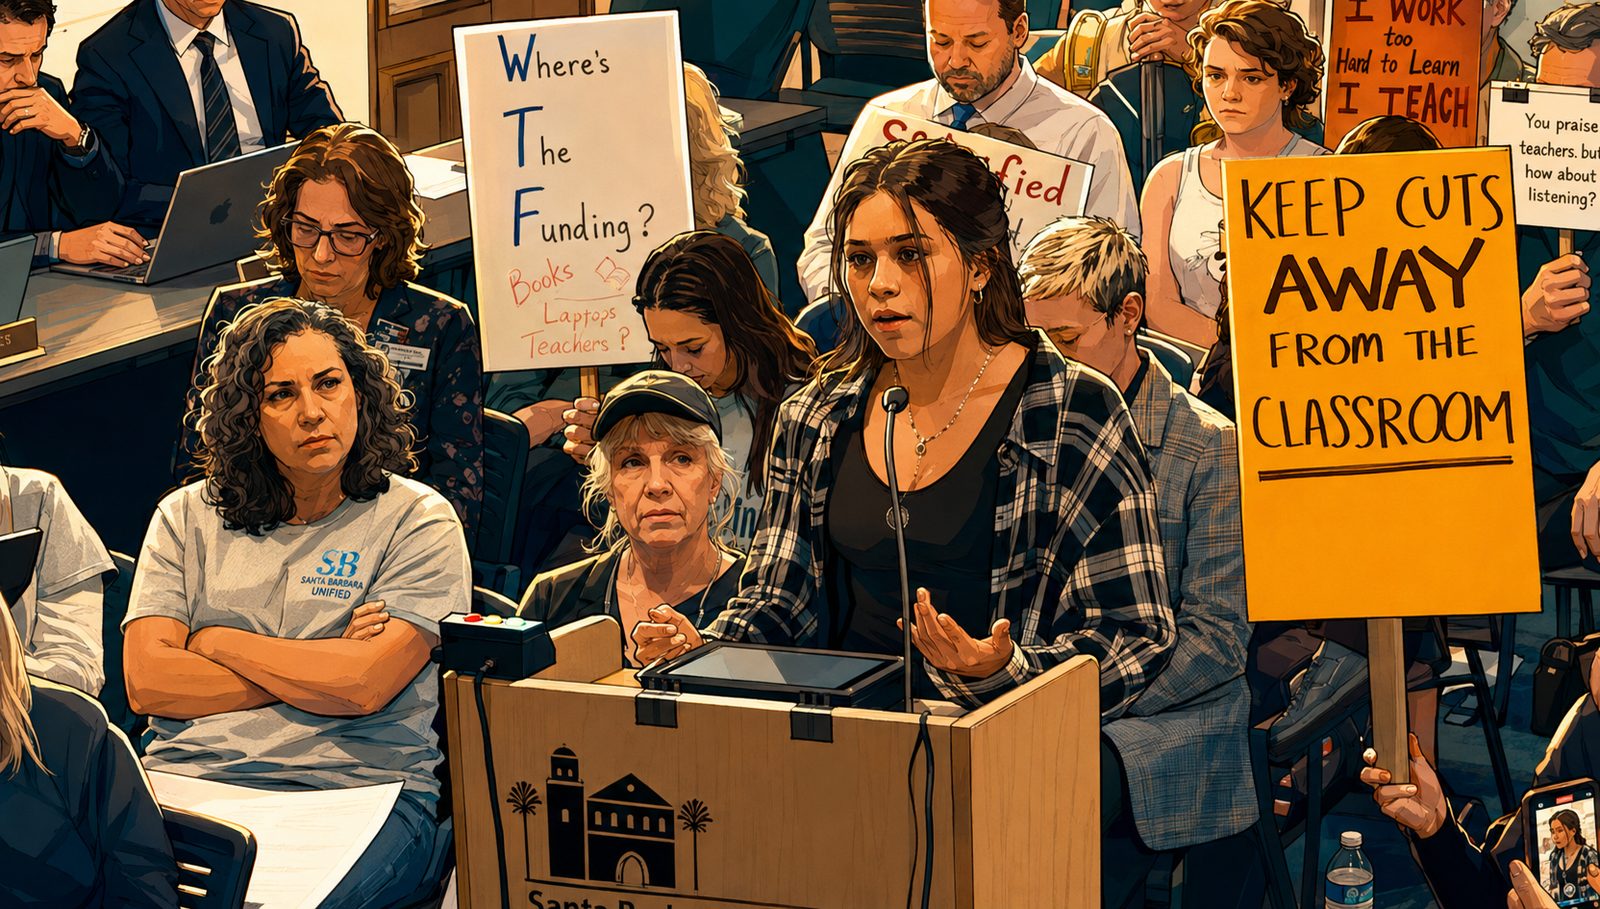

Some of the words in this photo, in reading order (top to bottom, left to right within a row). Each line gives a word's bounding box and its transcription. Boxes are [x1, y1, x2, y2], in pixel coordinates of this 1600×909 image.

[1345, 0, 1373, 22] I
[1390, 0, 1466, 26] WORK
[1384, 26, 1413, 47] too
[497, 33, 610, 82] Where's
[1336, 47, 1372, 74] Hard
[1381, 53, 1397, 73] to
[1409, 49, 1460, 76] Learn
[1338, 82, 1360, 114] I
[1378, 82, 1470, 128] TEACH
[503, 105, 572, 168] The
[1525, 112, 1550, 130] You
[1556, 114, 1599, 134] praise
[1525, 164, 1552, 181] how
[1557, 166, 1597, 183] about
[1241, 177, 1365, 240] KEEP
[1395, 174, 1504, 232] CUTS
[1528, 187, 1596, 210] listening?
[508, 257, 574, 306] Books
[1263, 237, 1485, 315] AWAY
[543, 302, 617, 331] Laptops
[1269, 325, 1384, 369] FROM
[1404, 325, 1479, 361] THE
[1251, 390, 1515, 449] CLASSROOM
[316, 548, 360, 577] SB
[311, 586, 351, 600] UNIFIED
[327, 577, 364, 590] BARBARA
